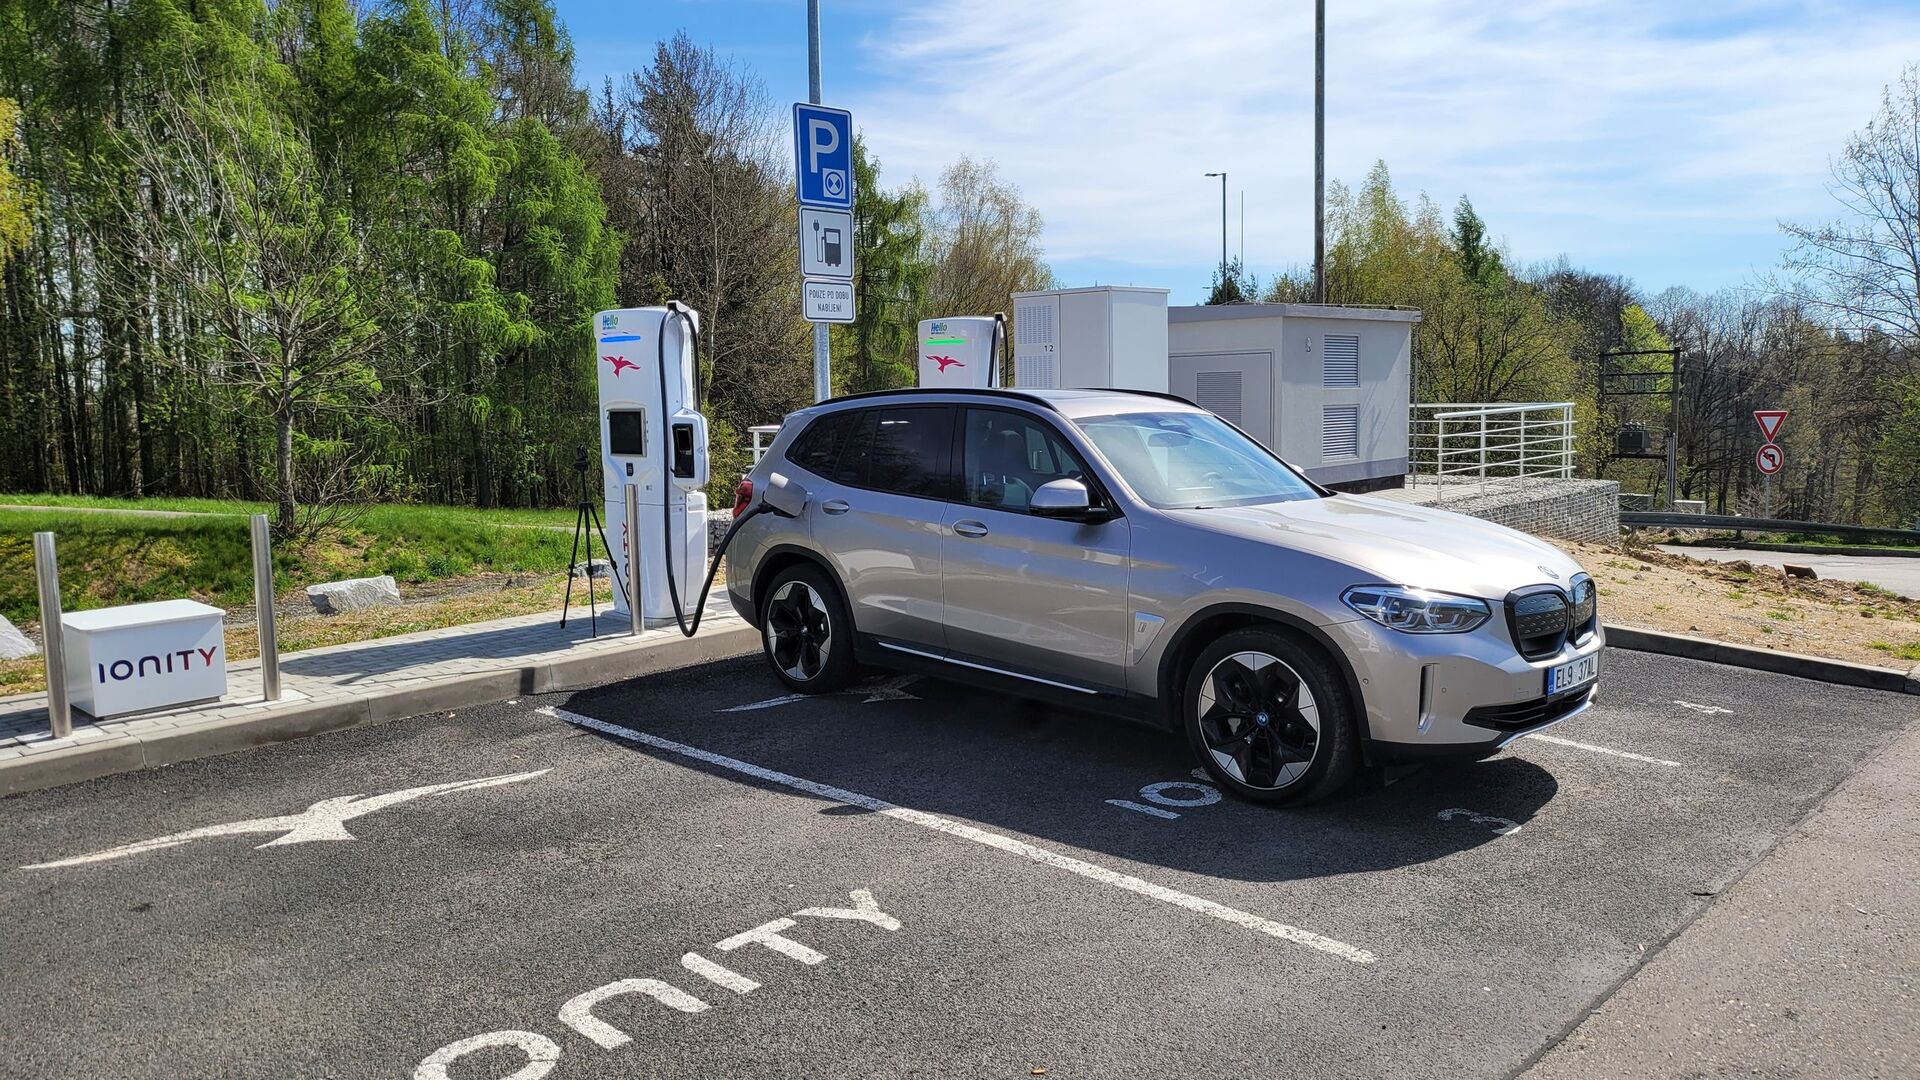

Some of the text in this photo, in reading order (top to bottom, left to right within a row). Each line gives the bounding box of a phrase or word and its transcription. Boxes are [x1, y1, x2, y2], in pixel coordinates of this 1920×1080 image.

[808, 118, 840, 174] P
[809, 289, 849, 300] POUZE PO DOBU
[817, 302, 842, 313] NABÍJENÍ
[602, 315, 619, 326] Hello
[931, 322, 948, 332] Hello
[98, 646, 218, 684] IONITY
[1556, 656, 1596, 689] EL9 37AL
[413, 888, 902, 1080] ONITY
